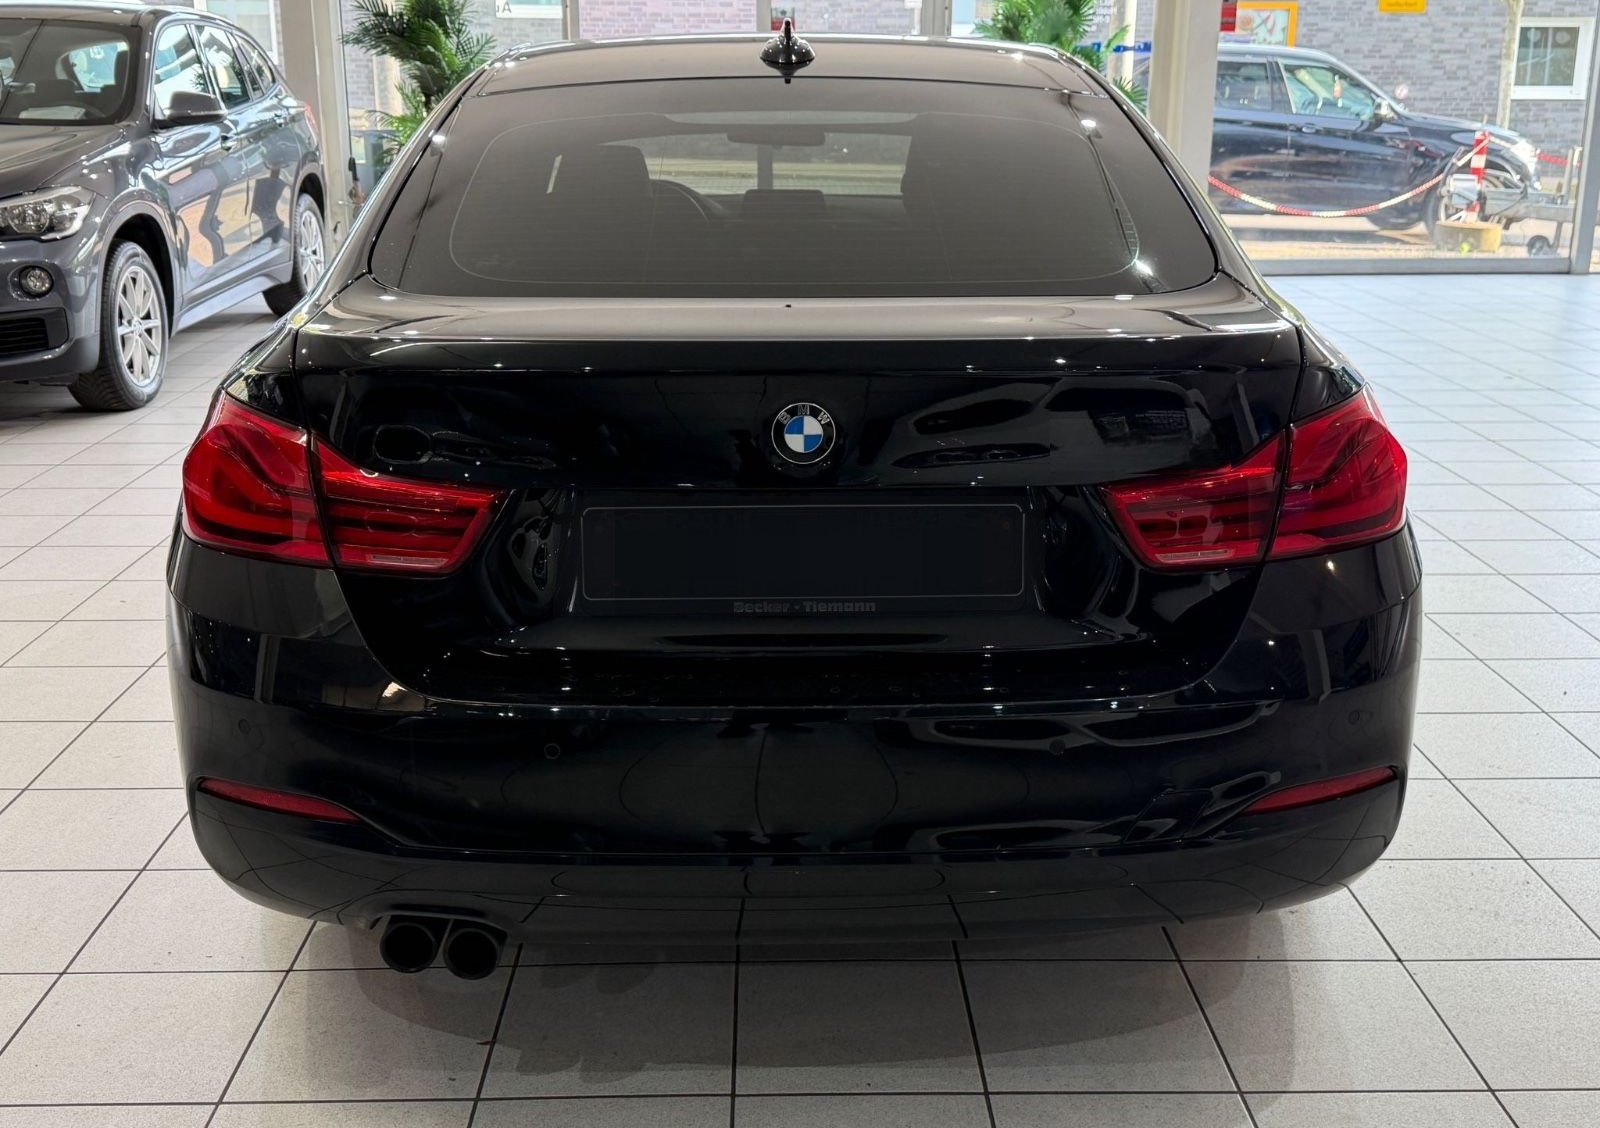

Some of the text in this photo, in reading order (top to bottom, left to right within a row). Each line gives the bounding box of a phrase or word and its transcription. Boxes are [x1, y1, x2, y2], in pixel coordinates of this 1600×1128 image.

[777, 404, 831, 425] BMW
[733, 601, 790, 613] Becker
[802, 601, 876, 612] Tiemann
